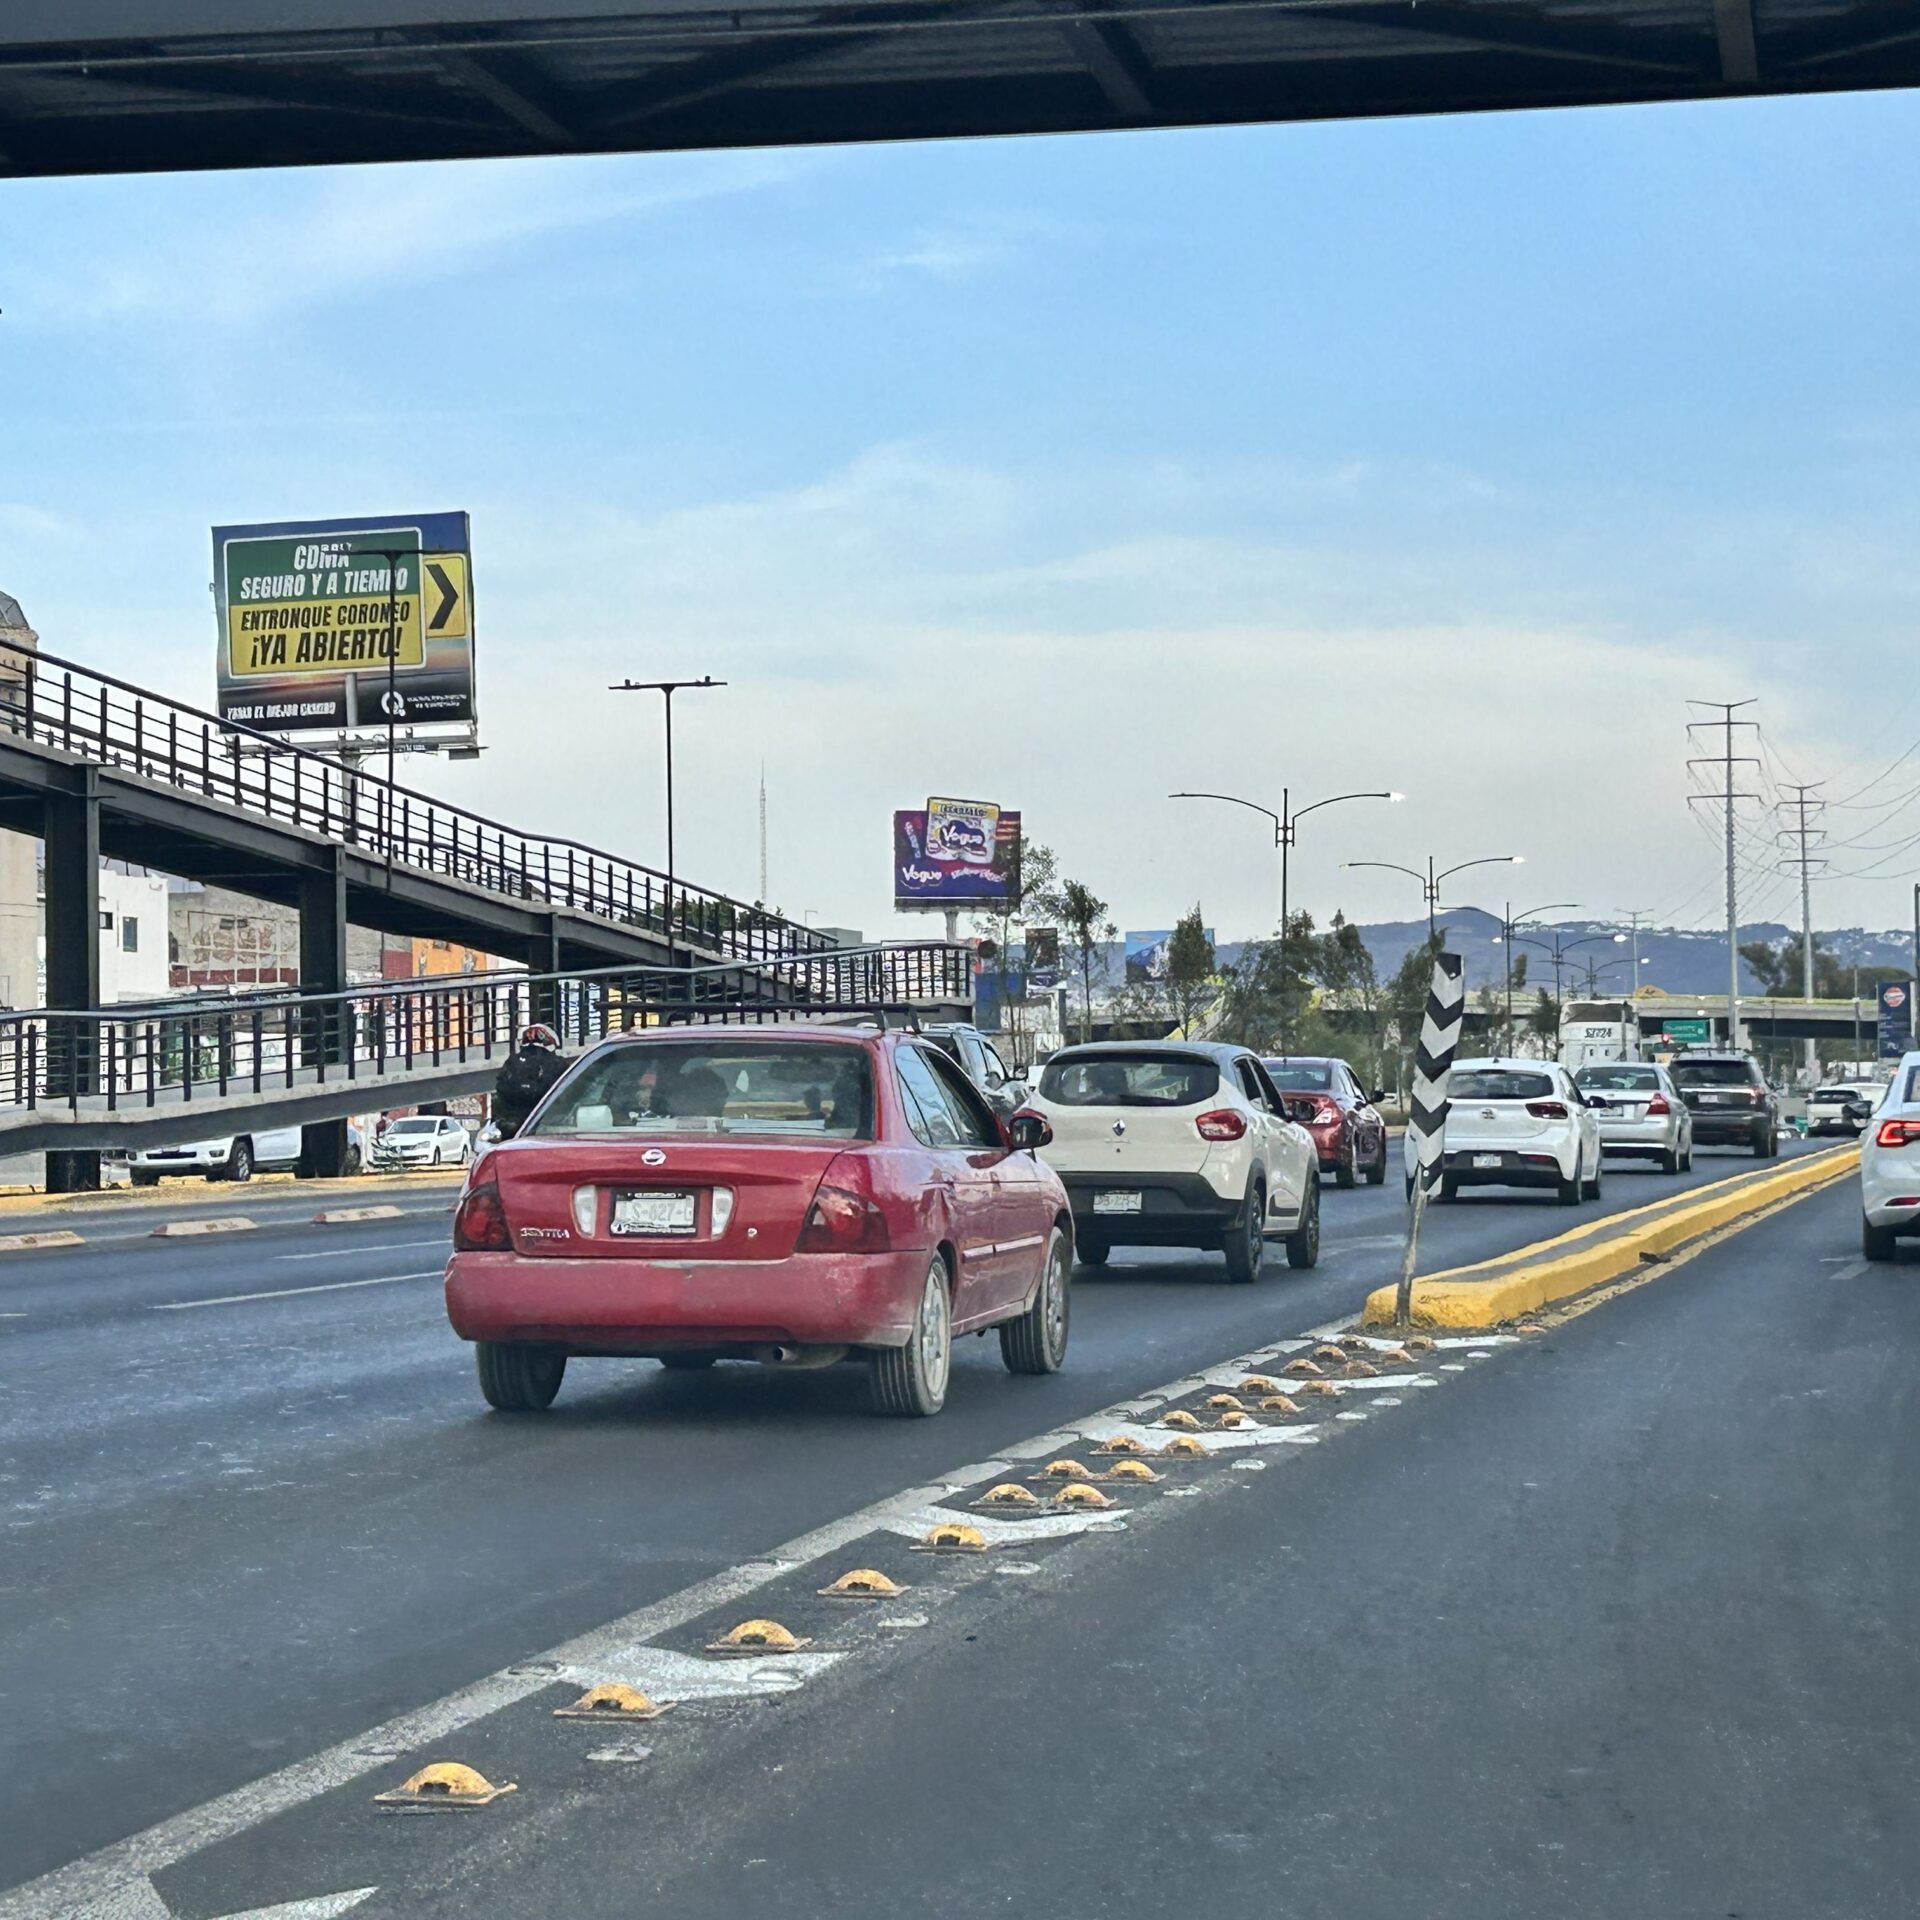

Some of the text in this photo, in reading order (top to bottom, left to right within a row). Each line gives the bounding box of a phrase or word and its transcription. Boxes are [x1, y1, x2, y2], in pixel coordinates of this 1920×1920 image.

[240, 567, 408, 600] SEGURO Y A TIEMO
[240, 601, 410, 631] ENTRONQUE CORONEO
[250, 626, 403, 668] ¡YA ABIERTO!
[902, 864, 943, 883] Vogue
